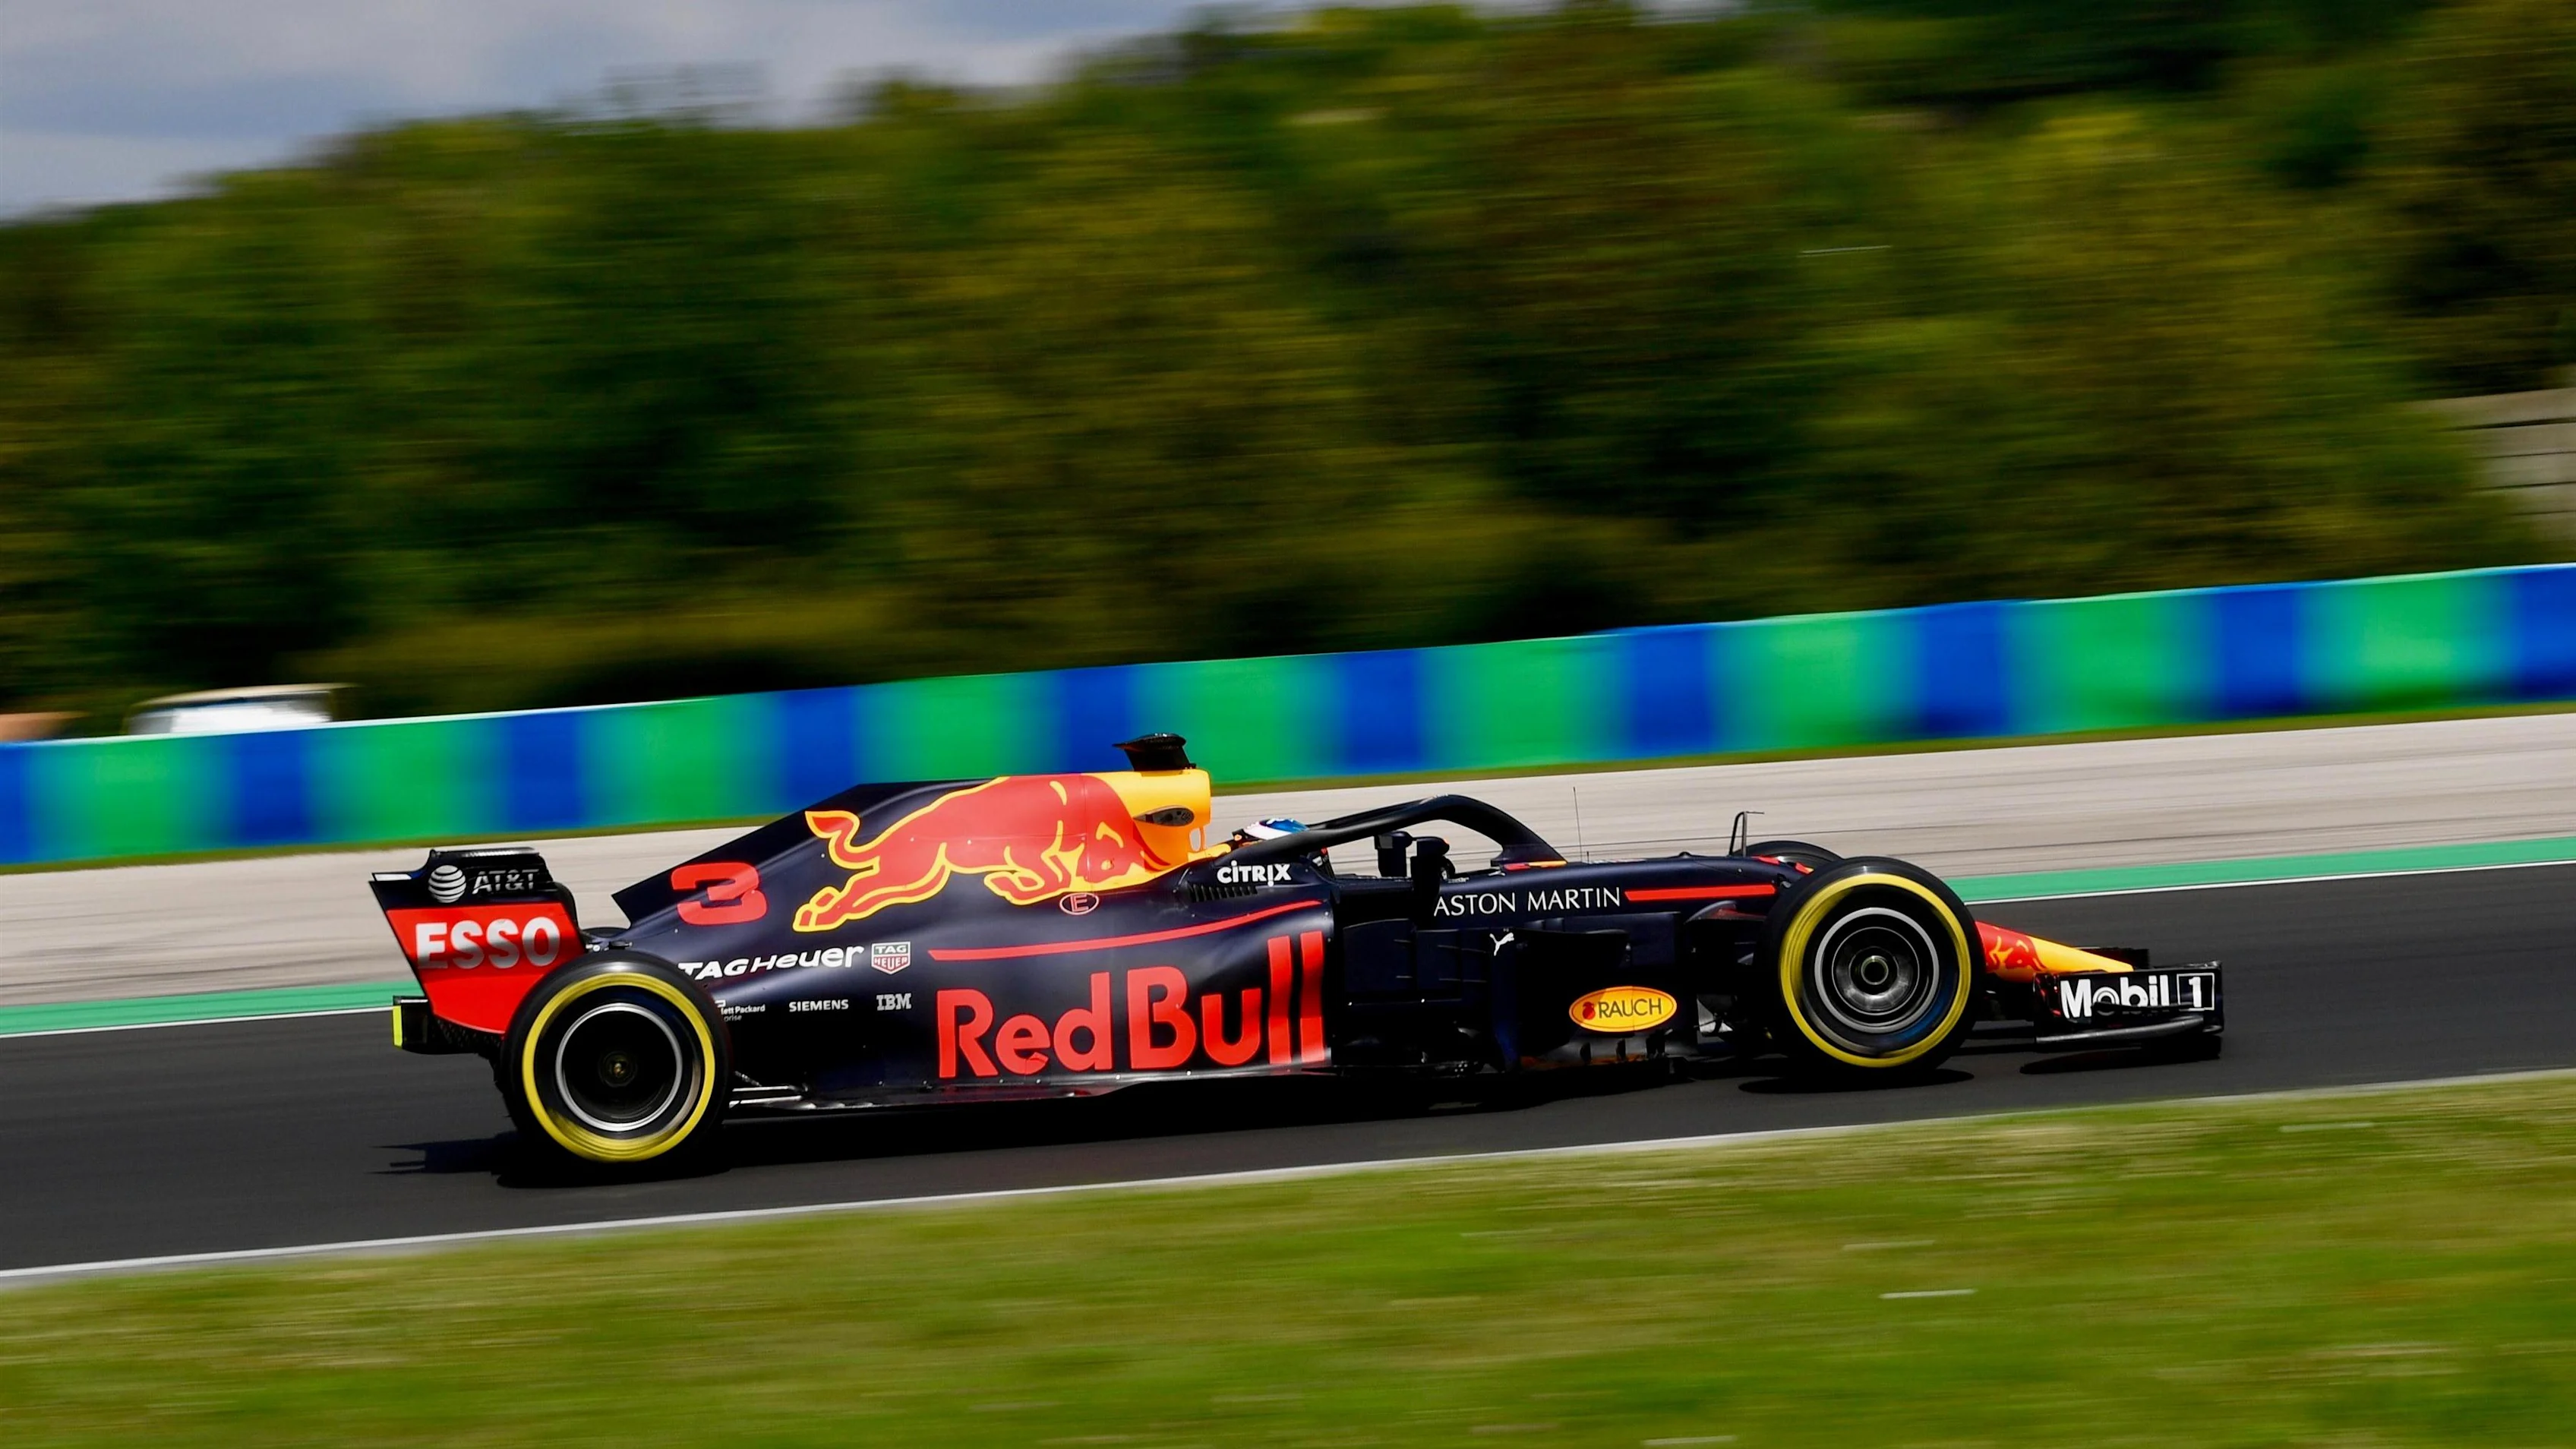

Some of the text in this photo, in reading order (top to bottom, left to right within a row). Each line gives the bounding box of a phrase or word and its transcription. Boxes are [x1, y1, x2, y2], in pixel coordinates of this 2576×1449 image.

[472, 869, 539, 895] AT&T
[671, 862, 768, 925] 3
[1434, 887, 1620, 917] ASTON MARTIN
[415, 917, 560, 969] ESSO
[874, 945, 907, 954] TAG
[873, 958, 908, 970] HEUER
[788, 999, 849, 1012] SIEMENS
[876, 993, 911, 1011] IBM
[2060, 974, 2202, 1018] Mobil 1
[734, 1003, 766, 1014] Packard
[1599, 998, 1662, 1018] RAUCH
